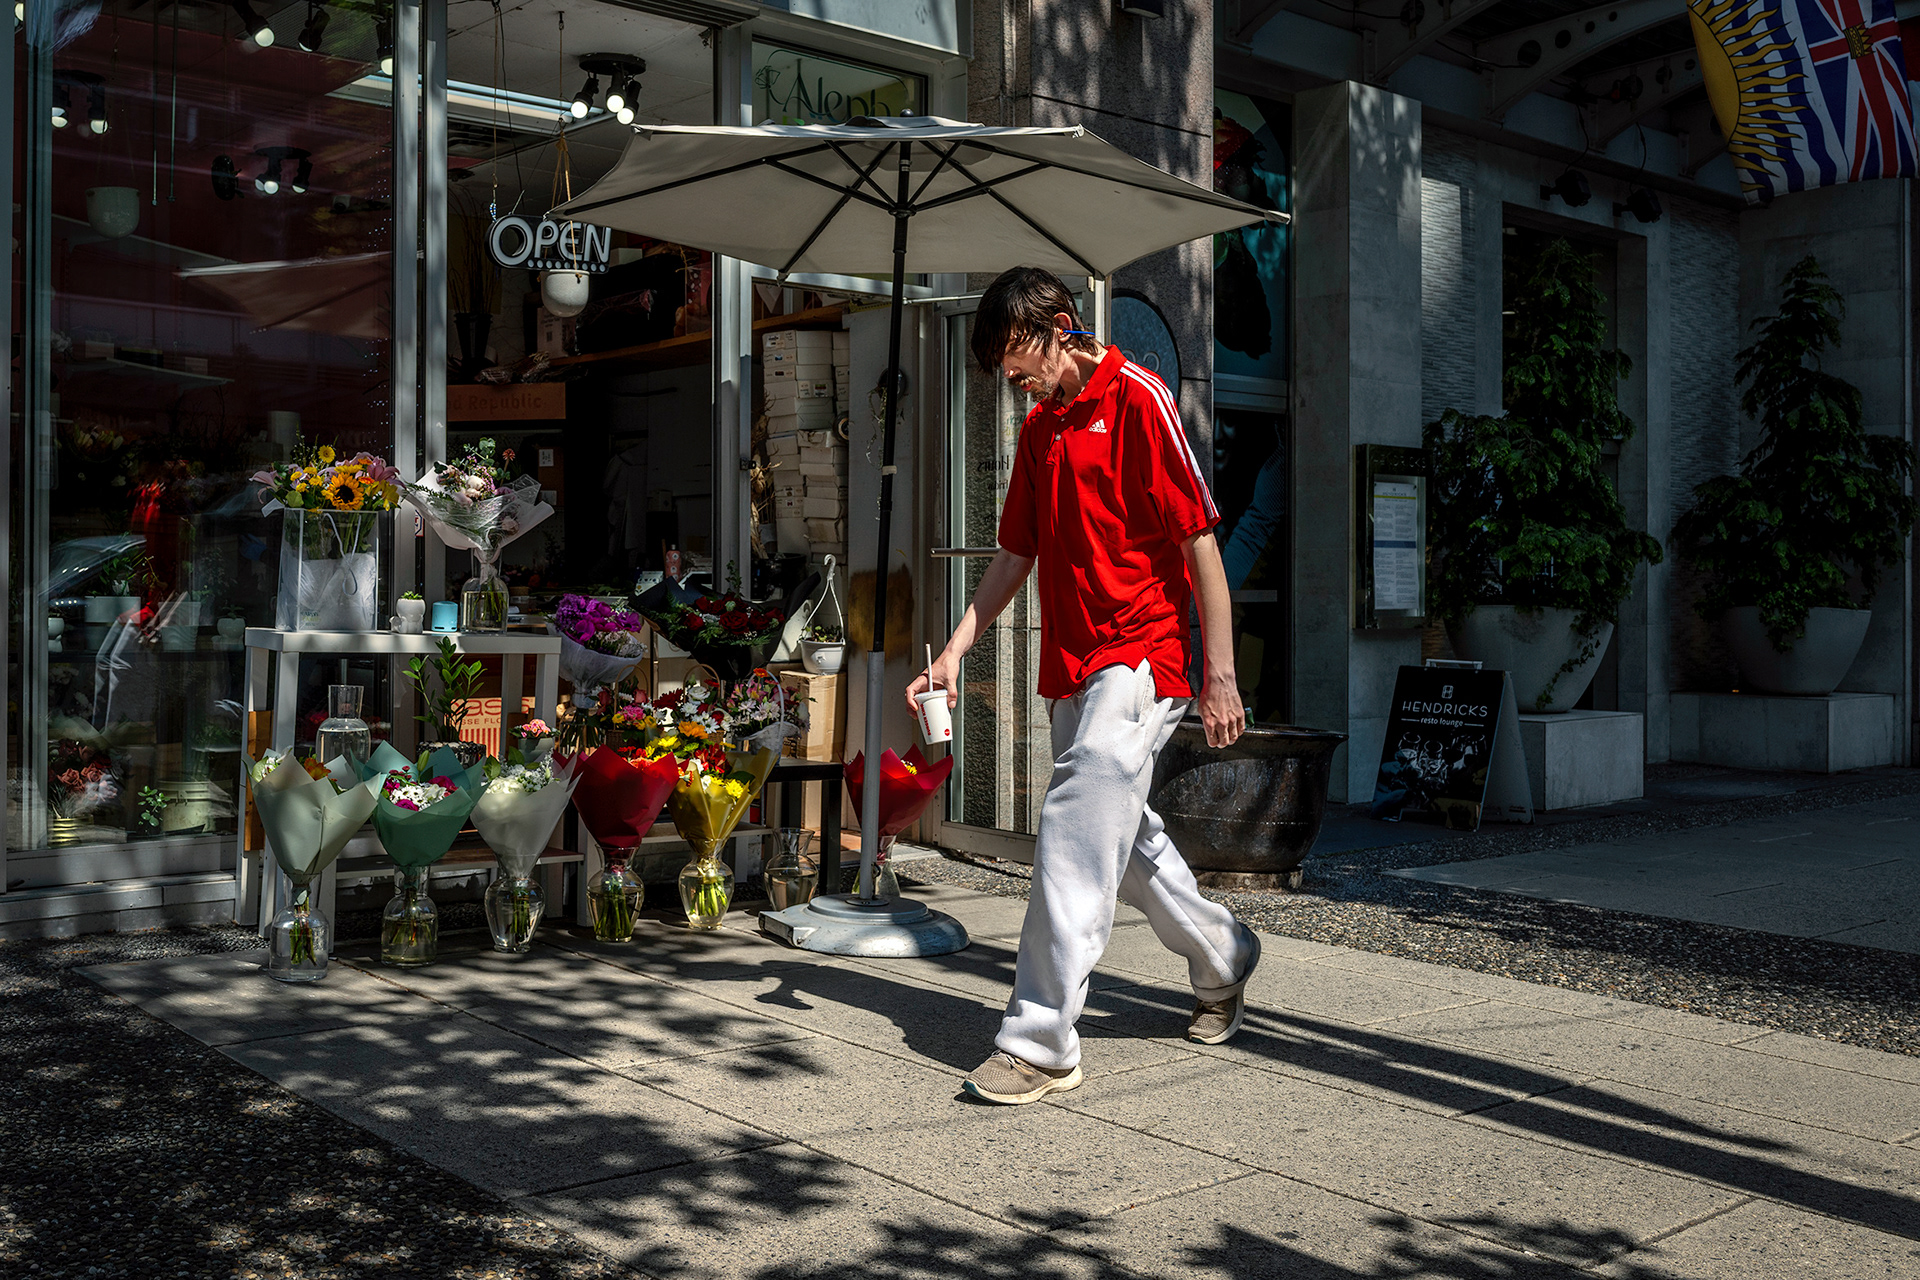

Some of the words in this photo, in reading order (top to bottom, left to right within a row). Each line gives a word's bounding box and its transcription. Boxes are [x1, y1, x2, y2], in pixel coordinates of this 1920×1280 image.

[782, 71, 891, 123] Aleph
[491, 215, 613, 267] OPEN
[469, 392, 542, 415] Republic
[1402, 700, 1488, 718] HENDRICKS
[1420, 717, 1439, 725] resto
[1440, 717, 1464, 728] lounge
